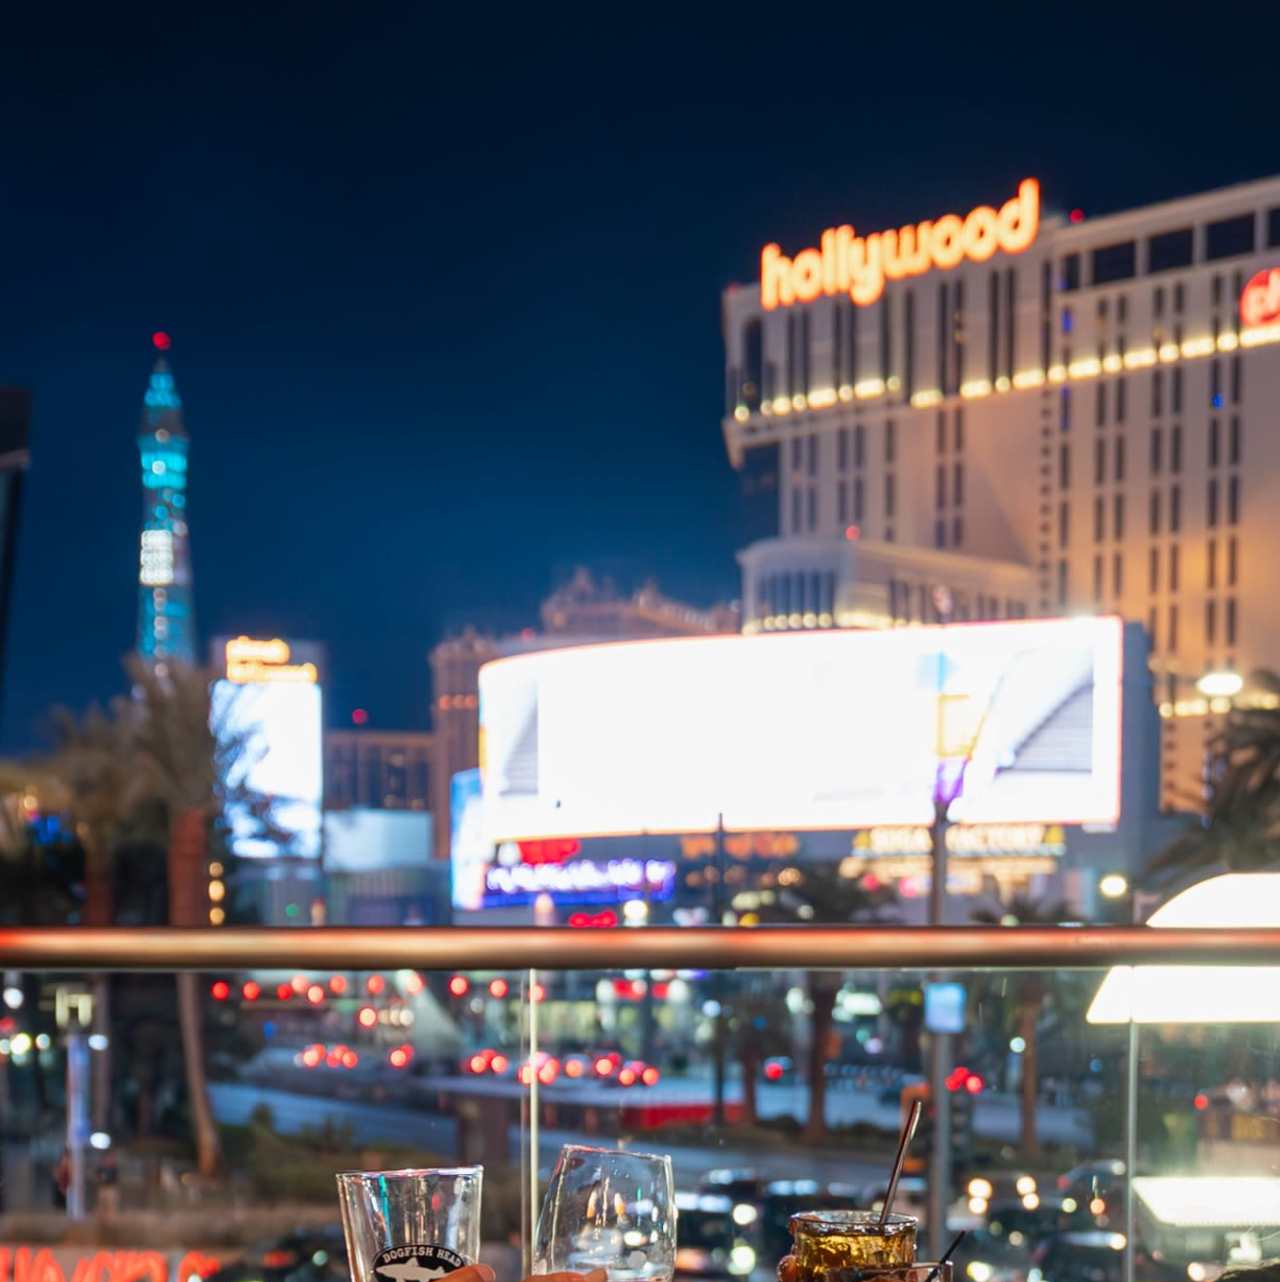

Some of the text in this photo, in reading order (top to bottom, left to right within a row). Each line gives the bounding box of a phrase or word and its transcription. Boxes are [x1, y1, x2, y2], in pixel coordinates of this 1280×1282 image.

[760, 177, 1040, 310] hollywood
[382, 1245, 463, 1268] DOGFISH HEAD
